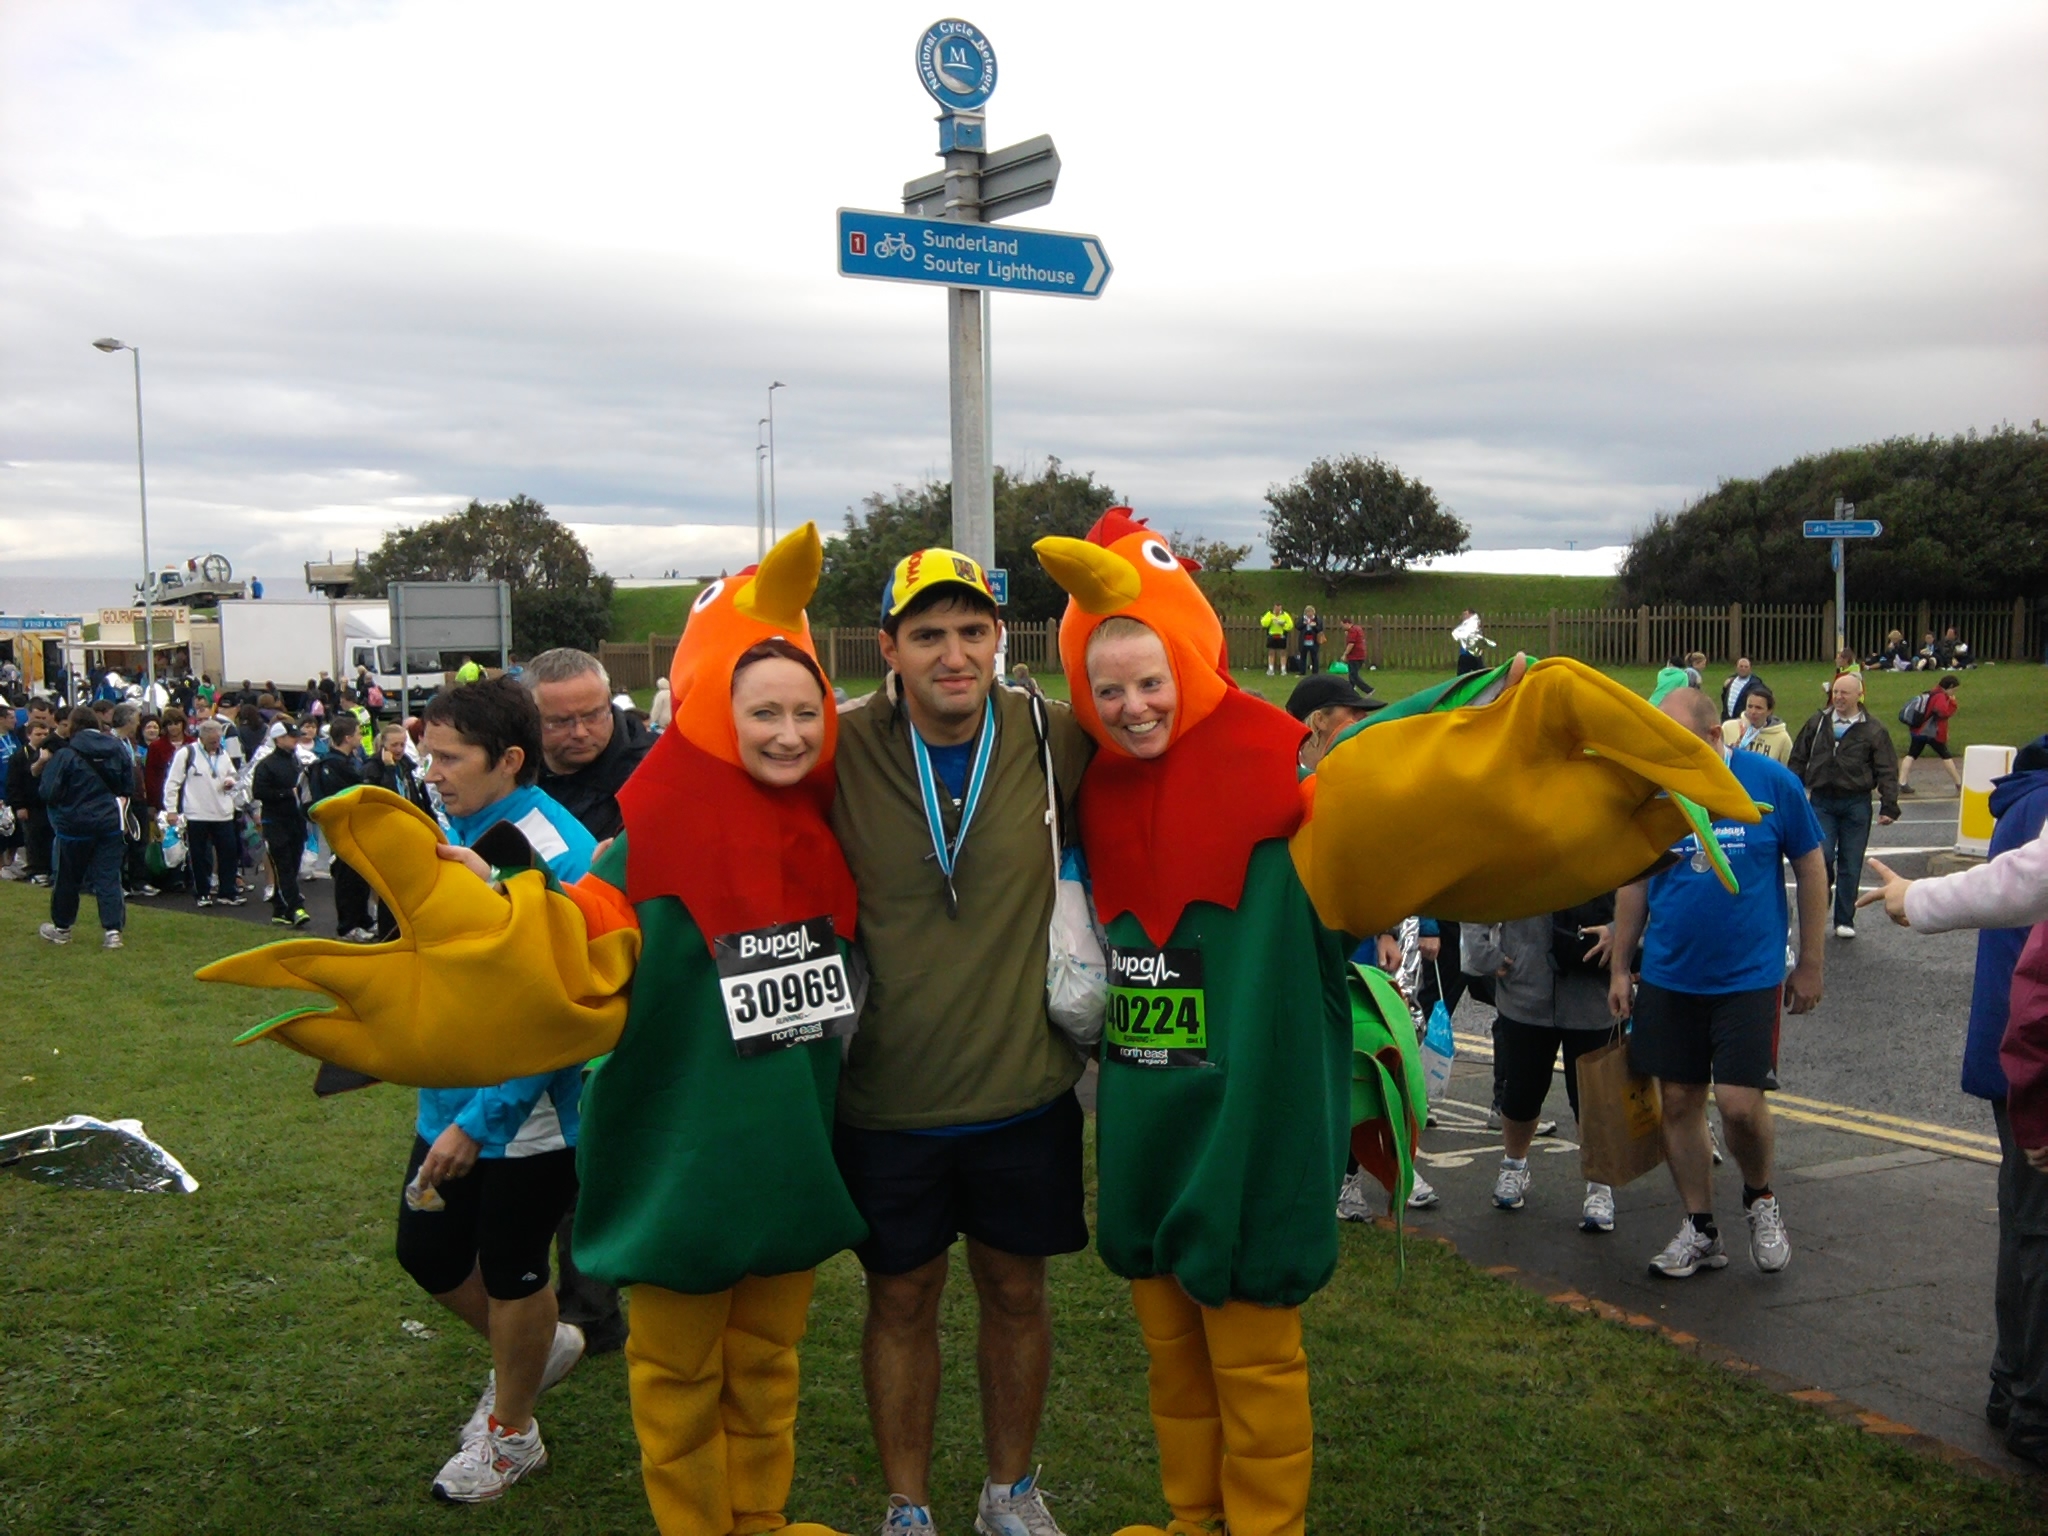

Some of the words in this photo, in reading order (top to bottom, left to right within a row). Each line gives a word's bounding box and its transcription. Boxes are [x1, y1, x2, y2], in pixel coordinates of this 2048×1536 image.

[921, 31, 941, 90] National
[939, 22, 973, 37] Cycle
[976, 39, 993, 94] Network
[923, 229, 1018, 256] Sunderland
[923, 254, 981, 275] Souter
[988, 260, 1075, 284] Lighthouse
[740, 931, 801, 958] Bupa
[1112, 949, 1155, 977] Bupa
[731, 964, 846, 1024] 30969
[1108, 993, 1200, 1035] 40224
[771, 1027, 798, 1042] north
[800, 1022, 823, 1035] east
[1120, 1047, 1142, 1058] north
[1144, 1048, 1169, 1059] east
